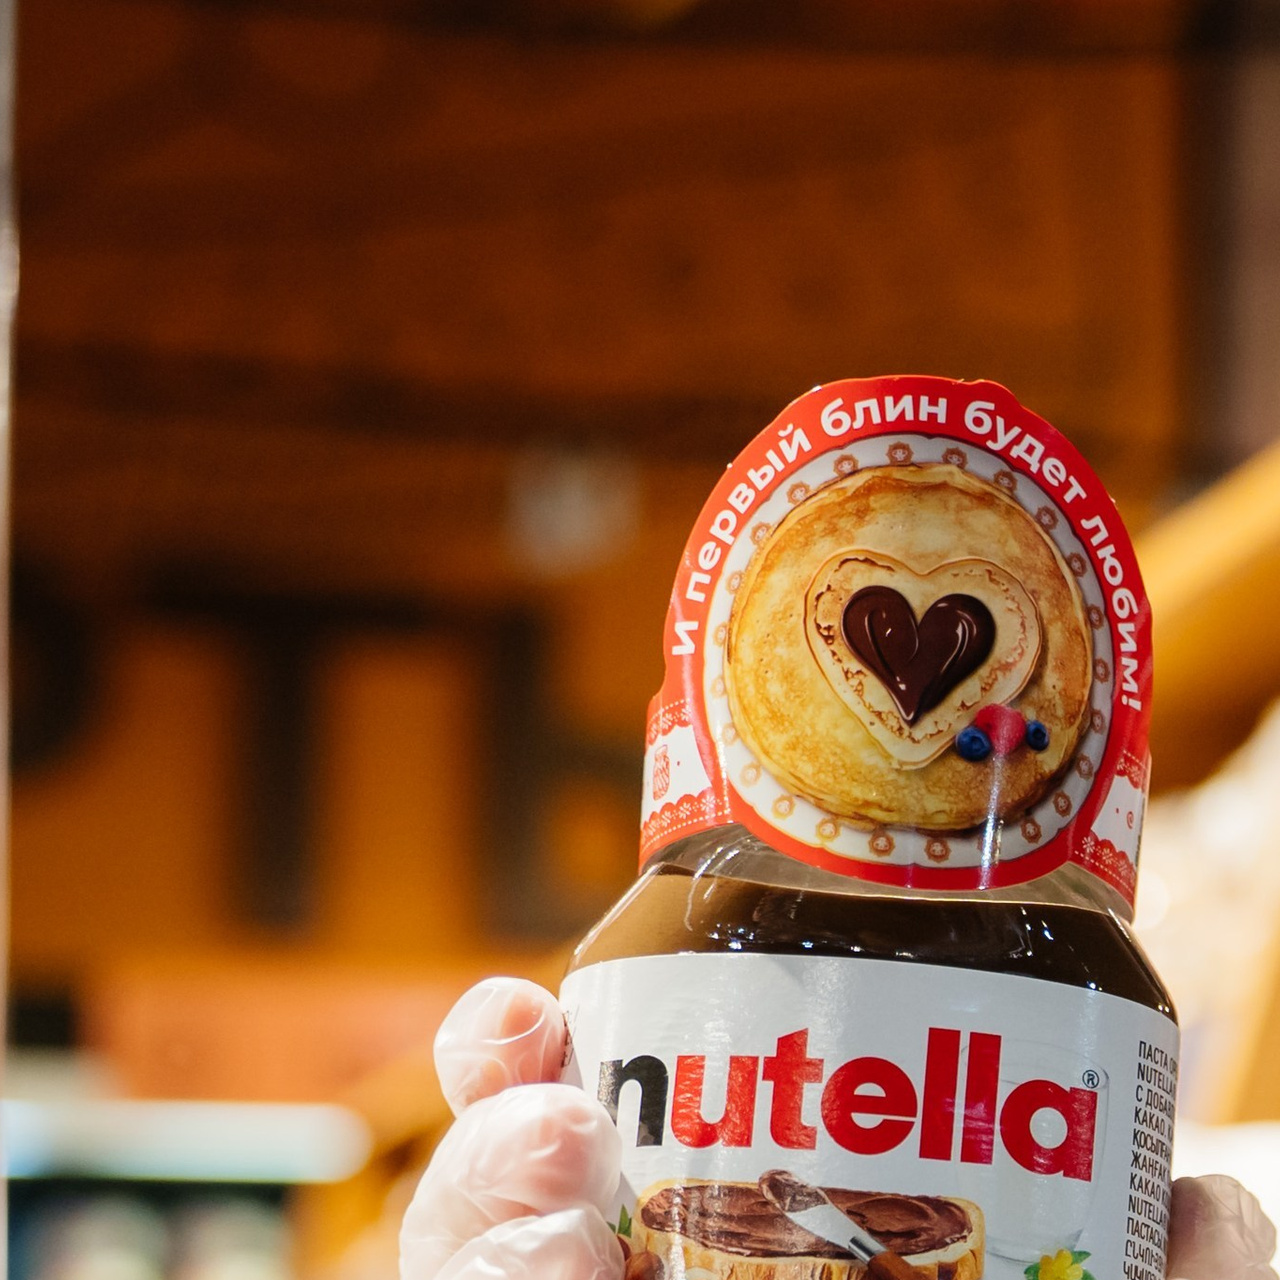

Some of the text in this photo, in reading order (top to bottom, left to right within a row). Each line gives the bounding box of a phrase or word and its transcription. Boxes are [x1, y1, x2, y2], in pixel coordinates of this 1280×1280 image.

[671, 394, 1143, 712] И первый блин будет любим!
[1138, 1040, 1168, 1071] ПАСТА
[597, 1026, 1099, 1182] nutella
[1135, 1085, 1143, 1102] С
[1129, 1172, 1161, 1202] КАКАО
